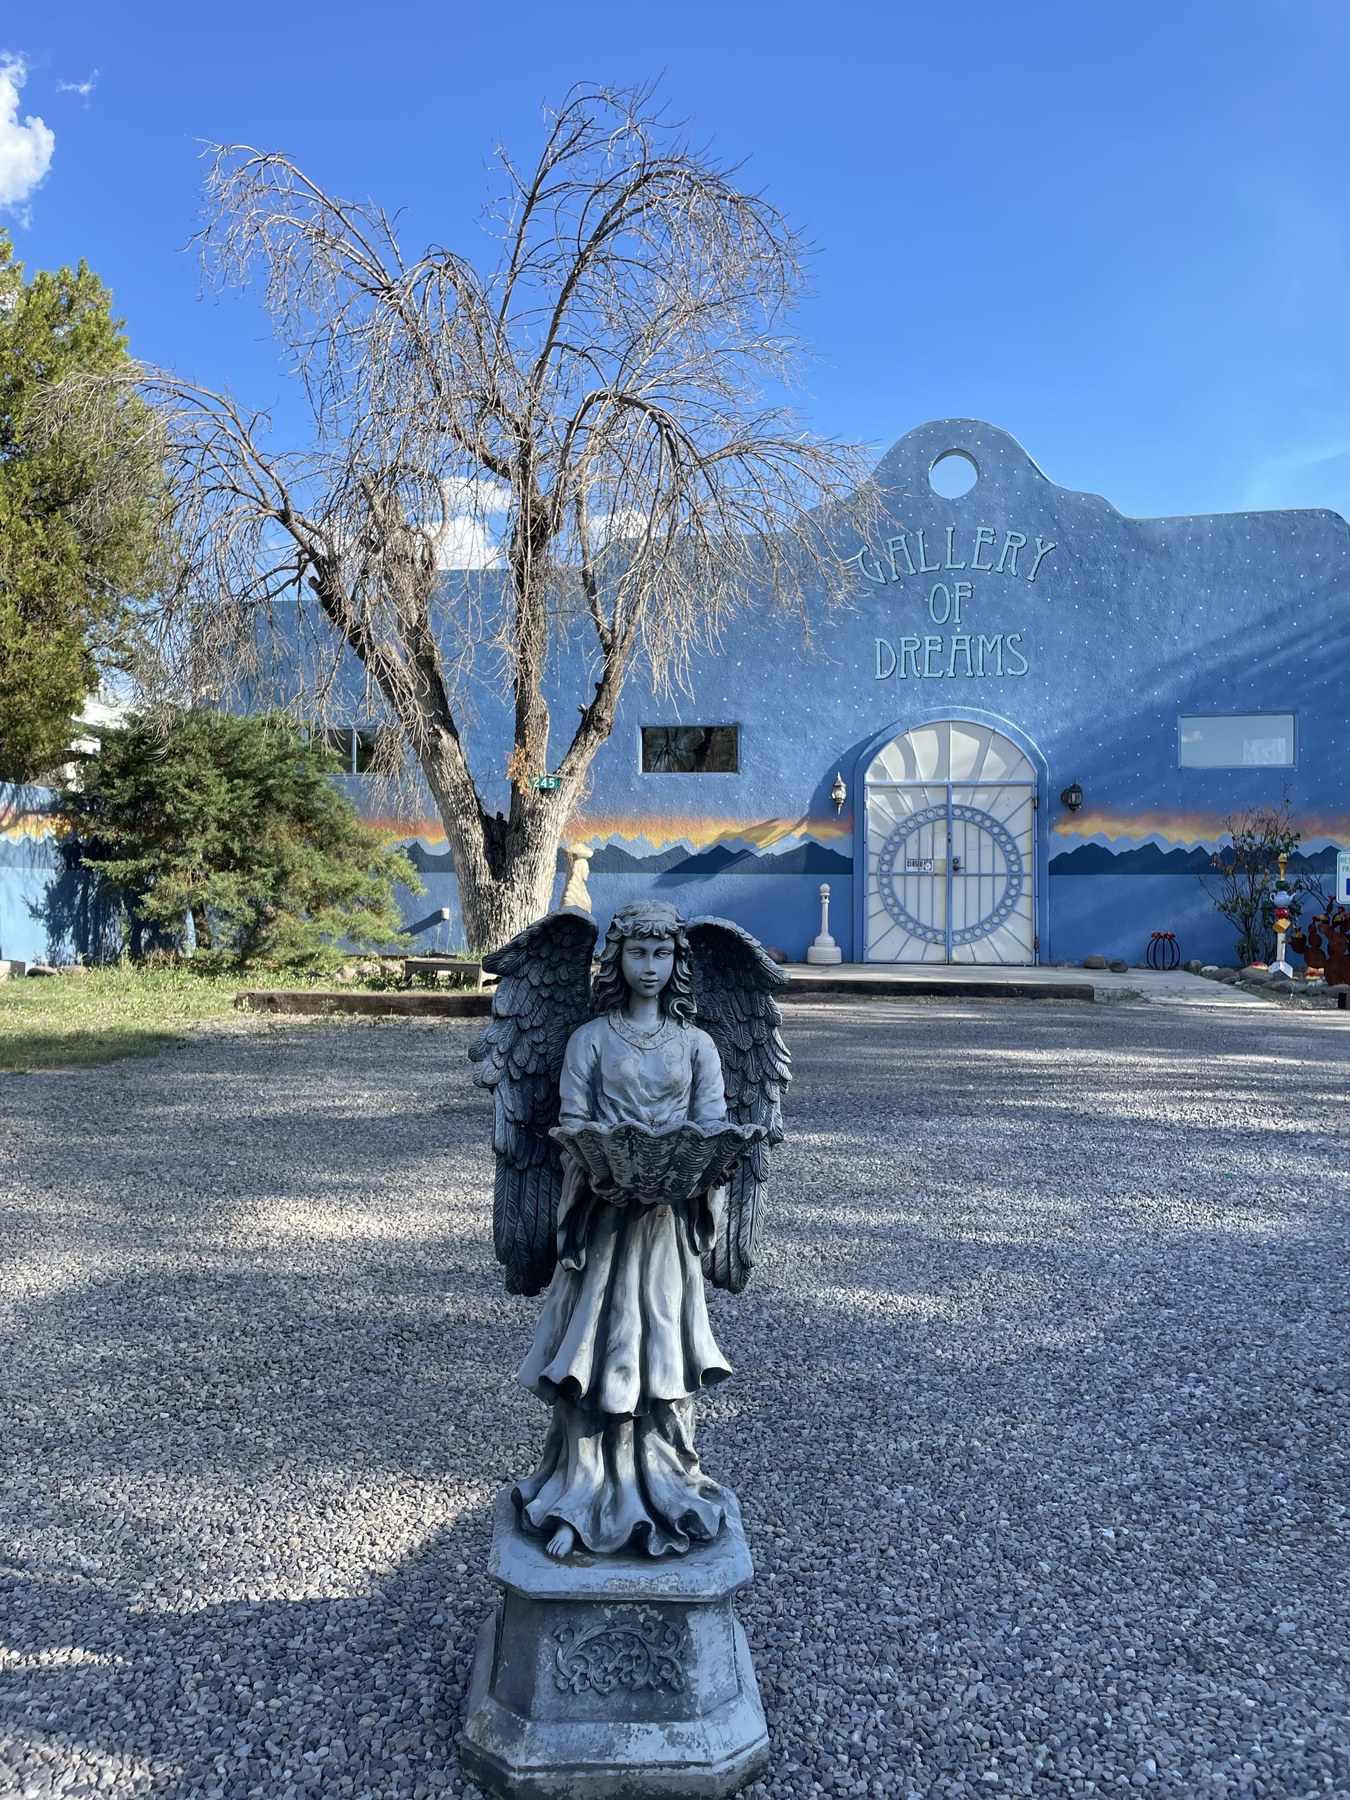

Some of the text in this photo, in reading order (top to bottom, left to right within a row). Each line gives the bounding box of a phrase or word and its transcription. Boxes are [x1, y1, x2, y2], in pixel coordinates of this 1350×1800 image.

[858, 526, 1056, 584] GALLERY
[929, 581, 973, 624] OF
[874, 633, 1029, 680] DREAMS
[533, 777, 555, 788] 245
[906, 860, 924, 868] CLOSD
